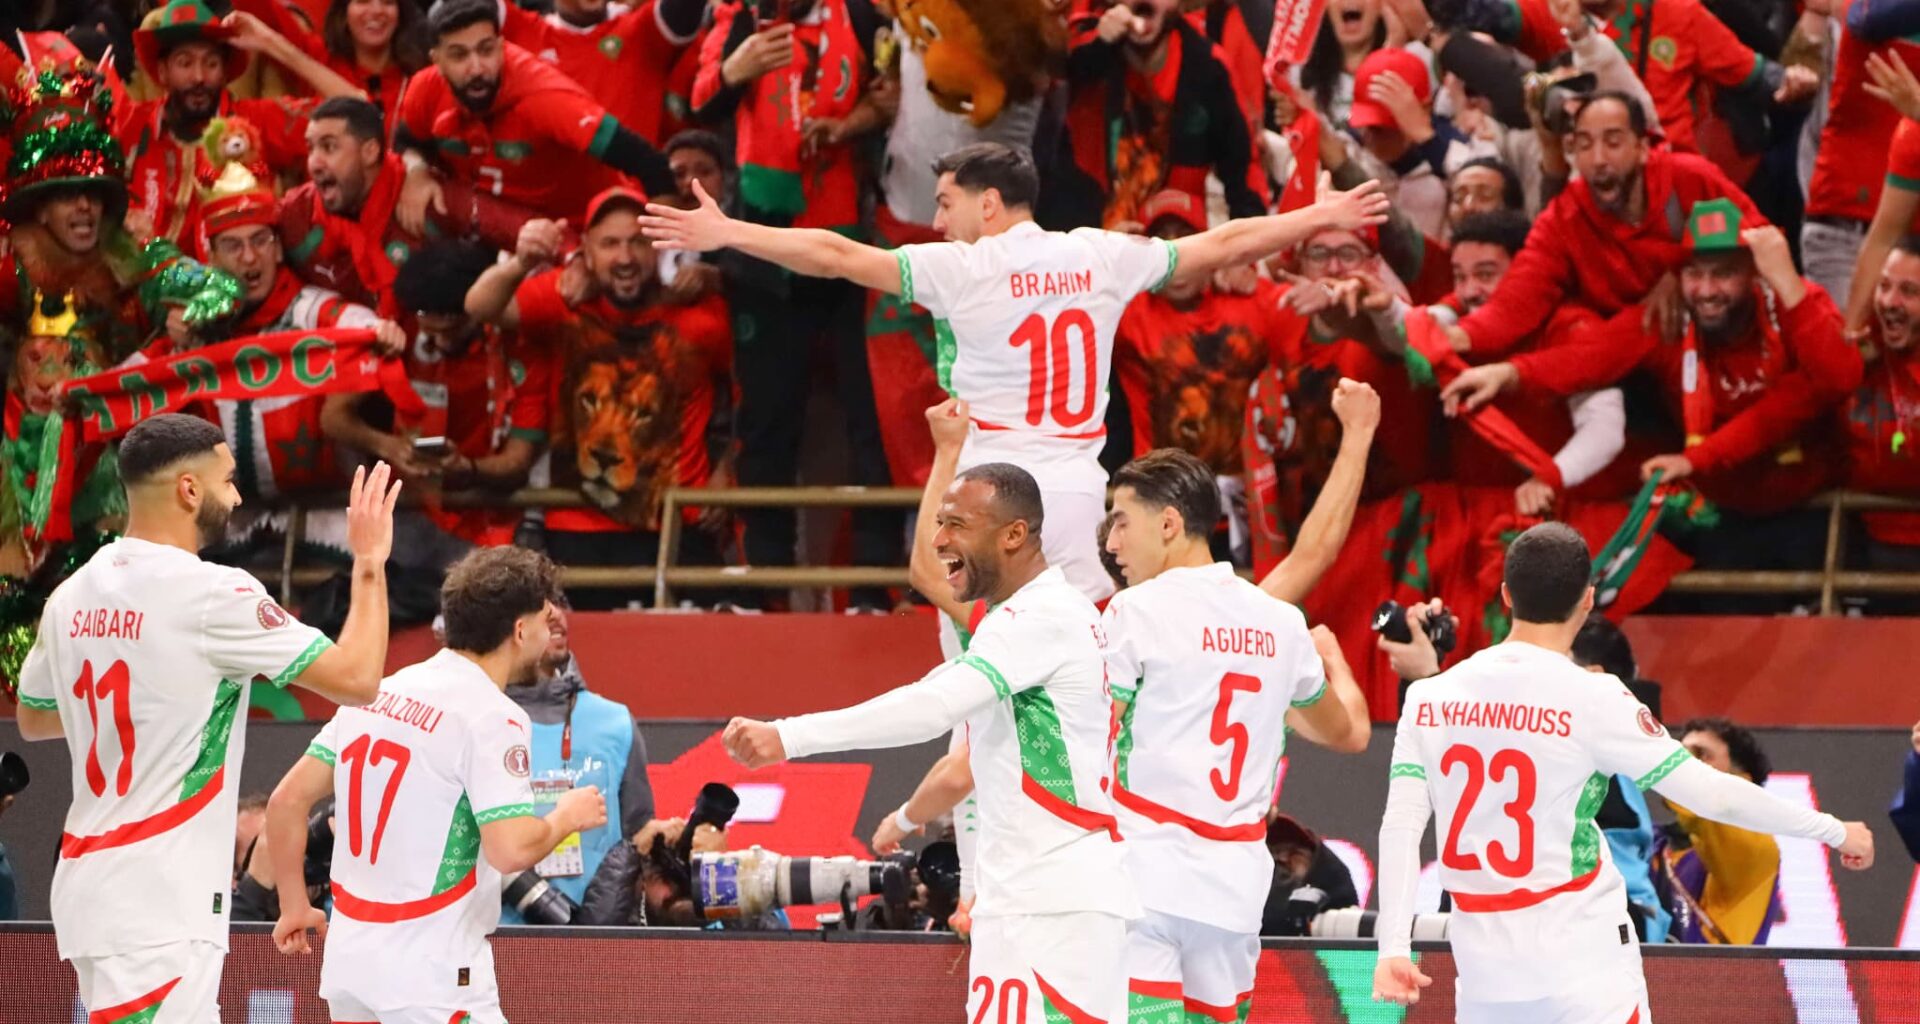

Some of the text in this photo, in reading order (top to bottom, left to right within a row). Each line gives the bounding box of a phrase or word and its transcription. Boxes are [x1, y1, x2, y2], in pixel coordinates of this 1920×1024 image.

[1010, 270, 1091, 298] BRAHIM
[1009, 309, 1097, 428] 10
[70, 608, 143, 640] SAIBARI
[1203, 626, 1276, 658] AGUERD
[73, 659, 135, 797] 11
[356, 691, 444, 733] ZALZOULI
[1416, 701, 1572, 737] EL KHANNOUSS
[1210, 671, 1262, 802] 5
[341, 733, 411, 865] 17
[1440, 744, 1537, 878] 23
[973, 976, 1028, 1024] 20
